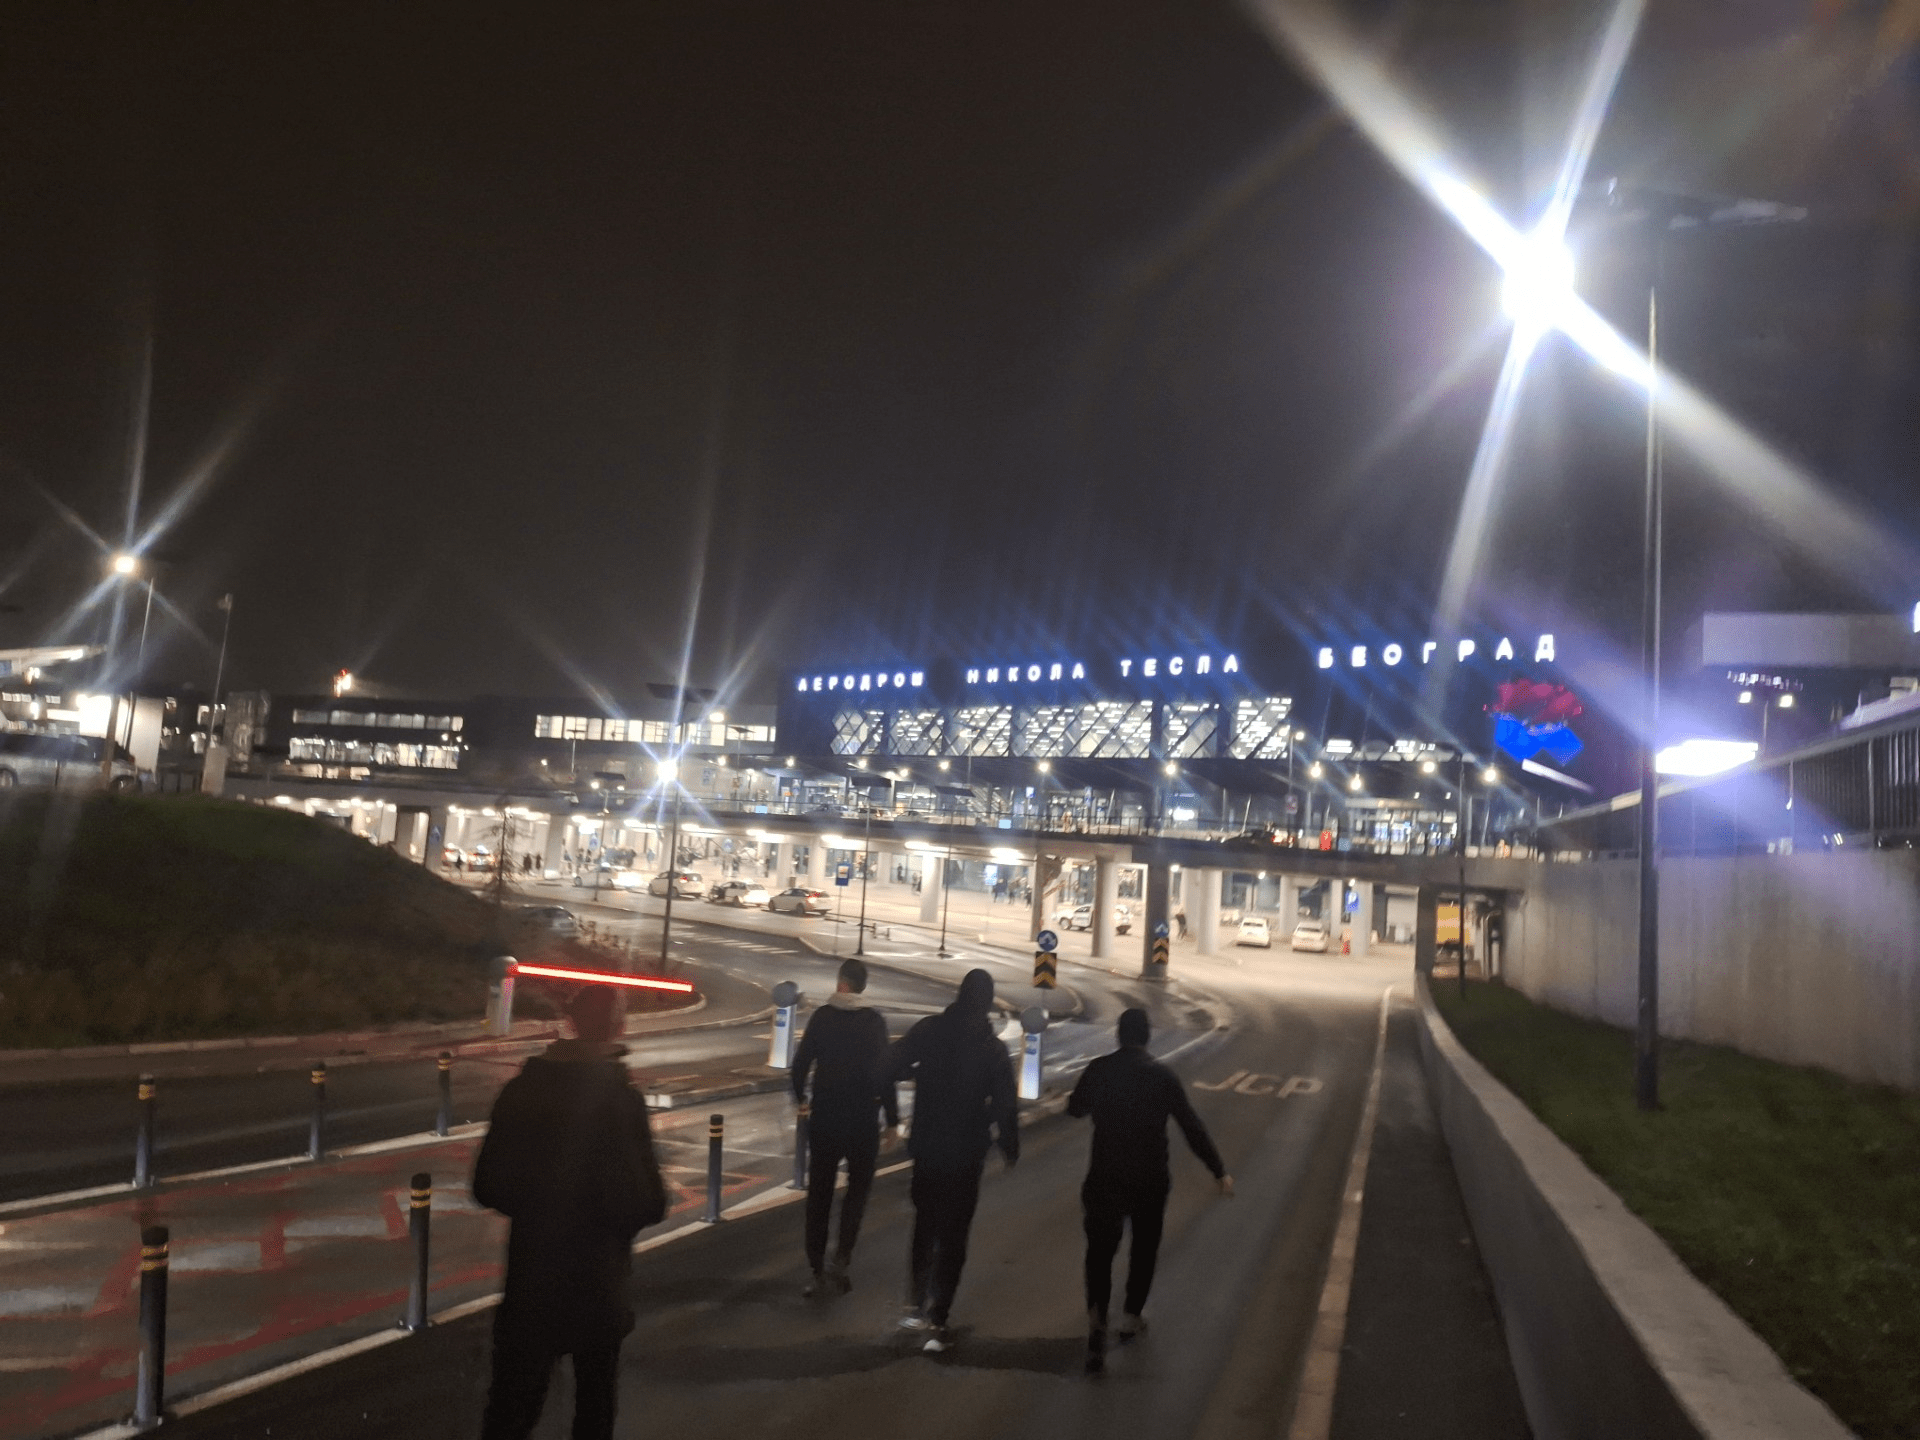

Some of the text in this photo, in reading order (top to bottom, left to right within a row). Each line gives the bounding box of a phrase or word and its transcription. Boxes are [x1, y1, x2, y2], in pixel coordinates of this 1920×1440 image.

[1318, 633, 1556, 669] БЕОГРАД
[797, 654, 1239, 692] АЕРОДРОМ НИКОЛА ТЕСЛА
